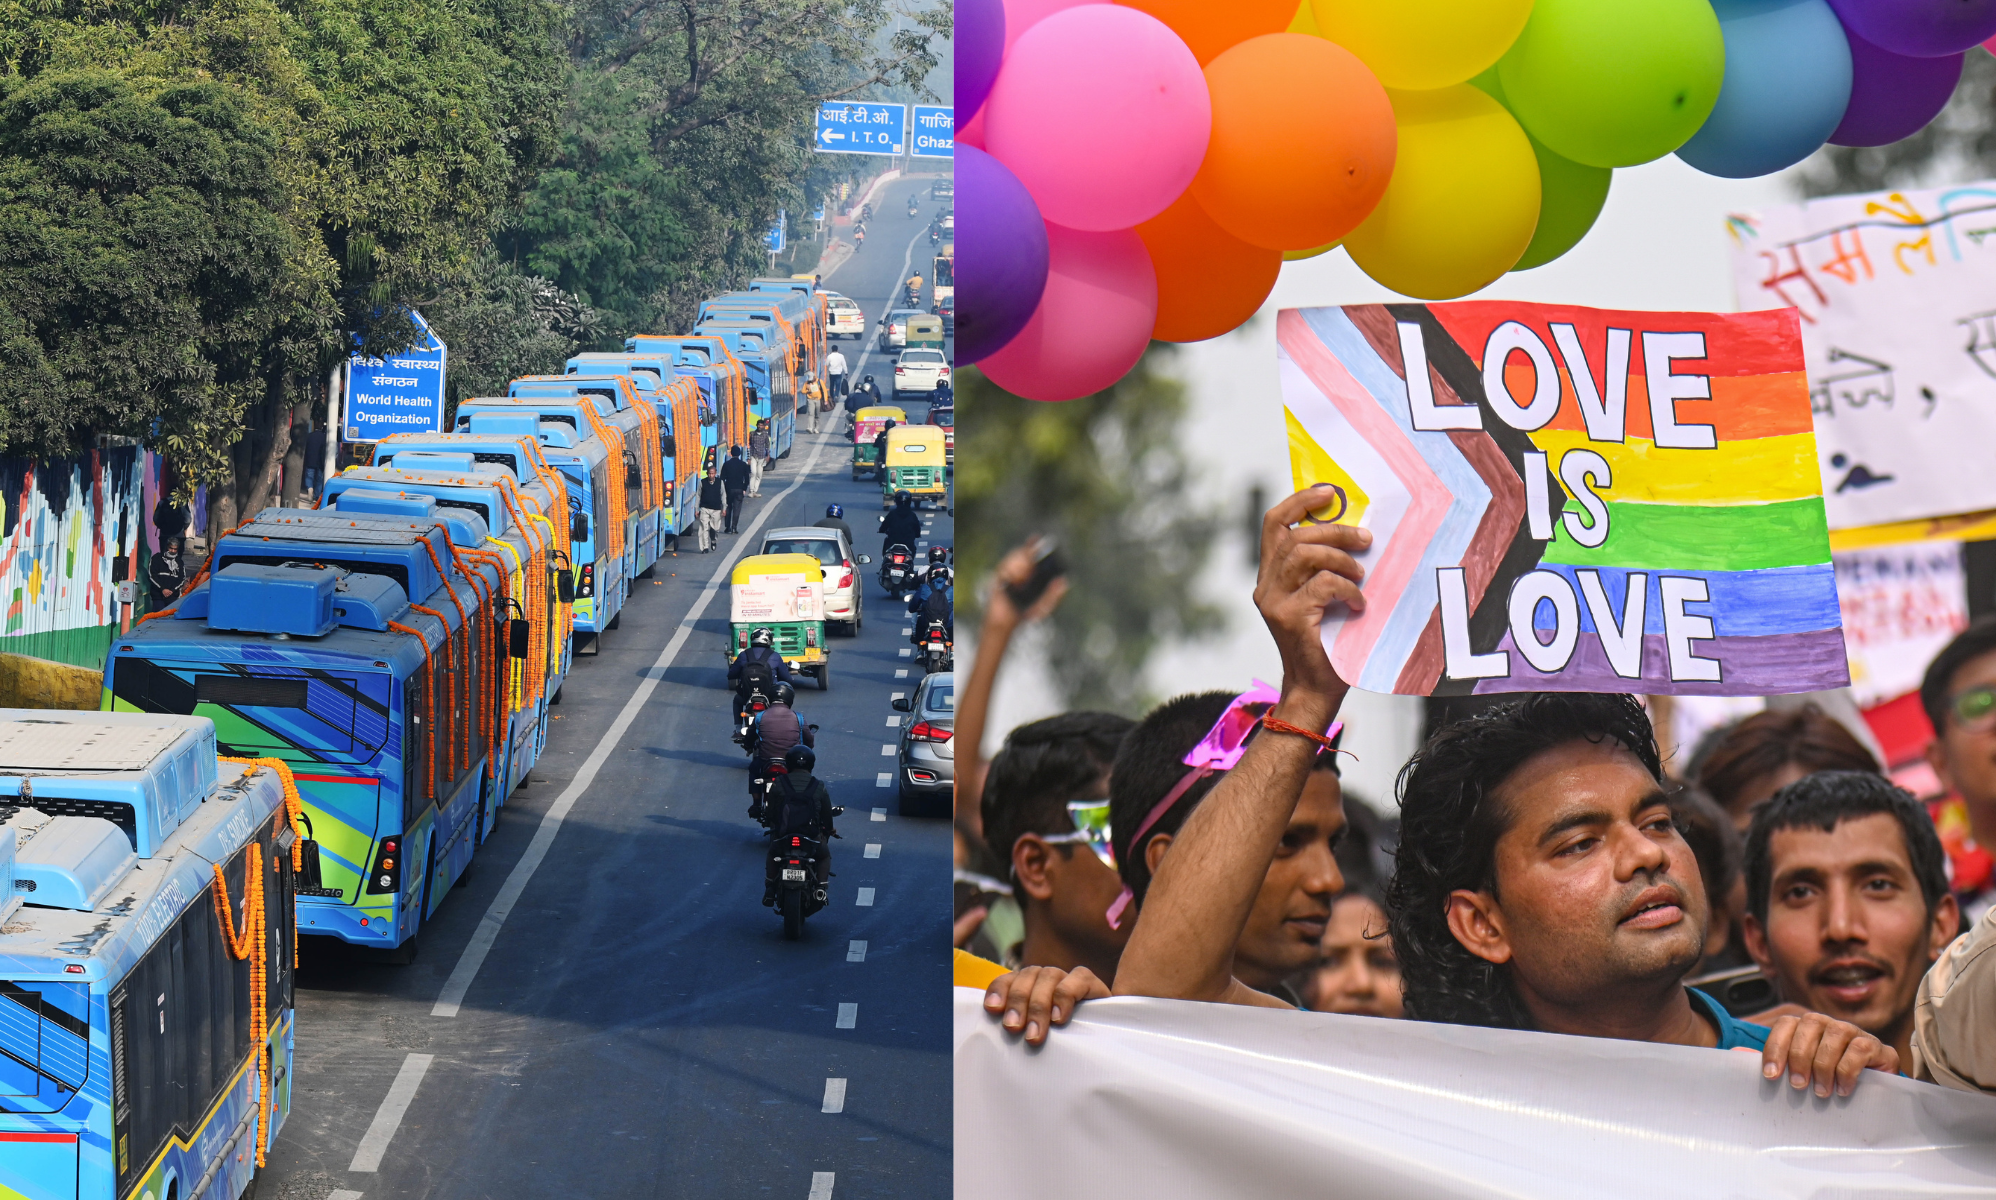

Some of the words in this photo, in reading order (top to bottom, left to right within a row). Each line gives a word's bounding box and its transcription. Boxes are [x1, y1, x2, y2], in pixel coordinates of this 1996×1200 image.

[919, 112, 954, 129] गाजि
[392, 359, 440, 370] स्वास्थ्य
[372, 373, 418, 388] संगठन
[1396, 319, 1718, 450] LOVE
[356, 394, 392, 406] World
[394, 396, 432, 407] Health
[356, 411, 430, 424] Organization
[1523, 447, 1612, 549] IS
[1436, 566, 1724, 683] LOVE
[226, 807, 254, 851] SMOKE
